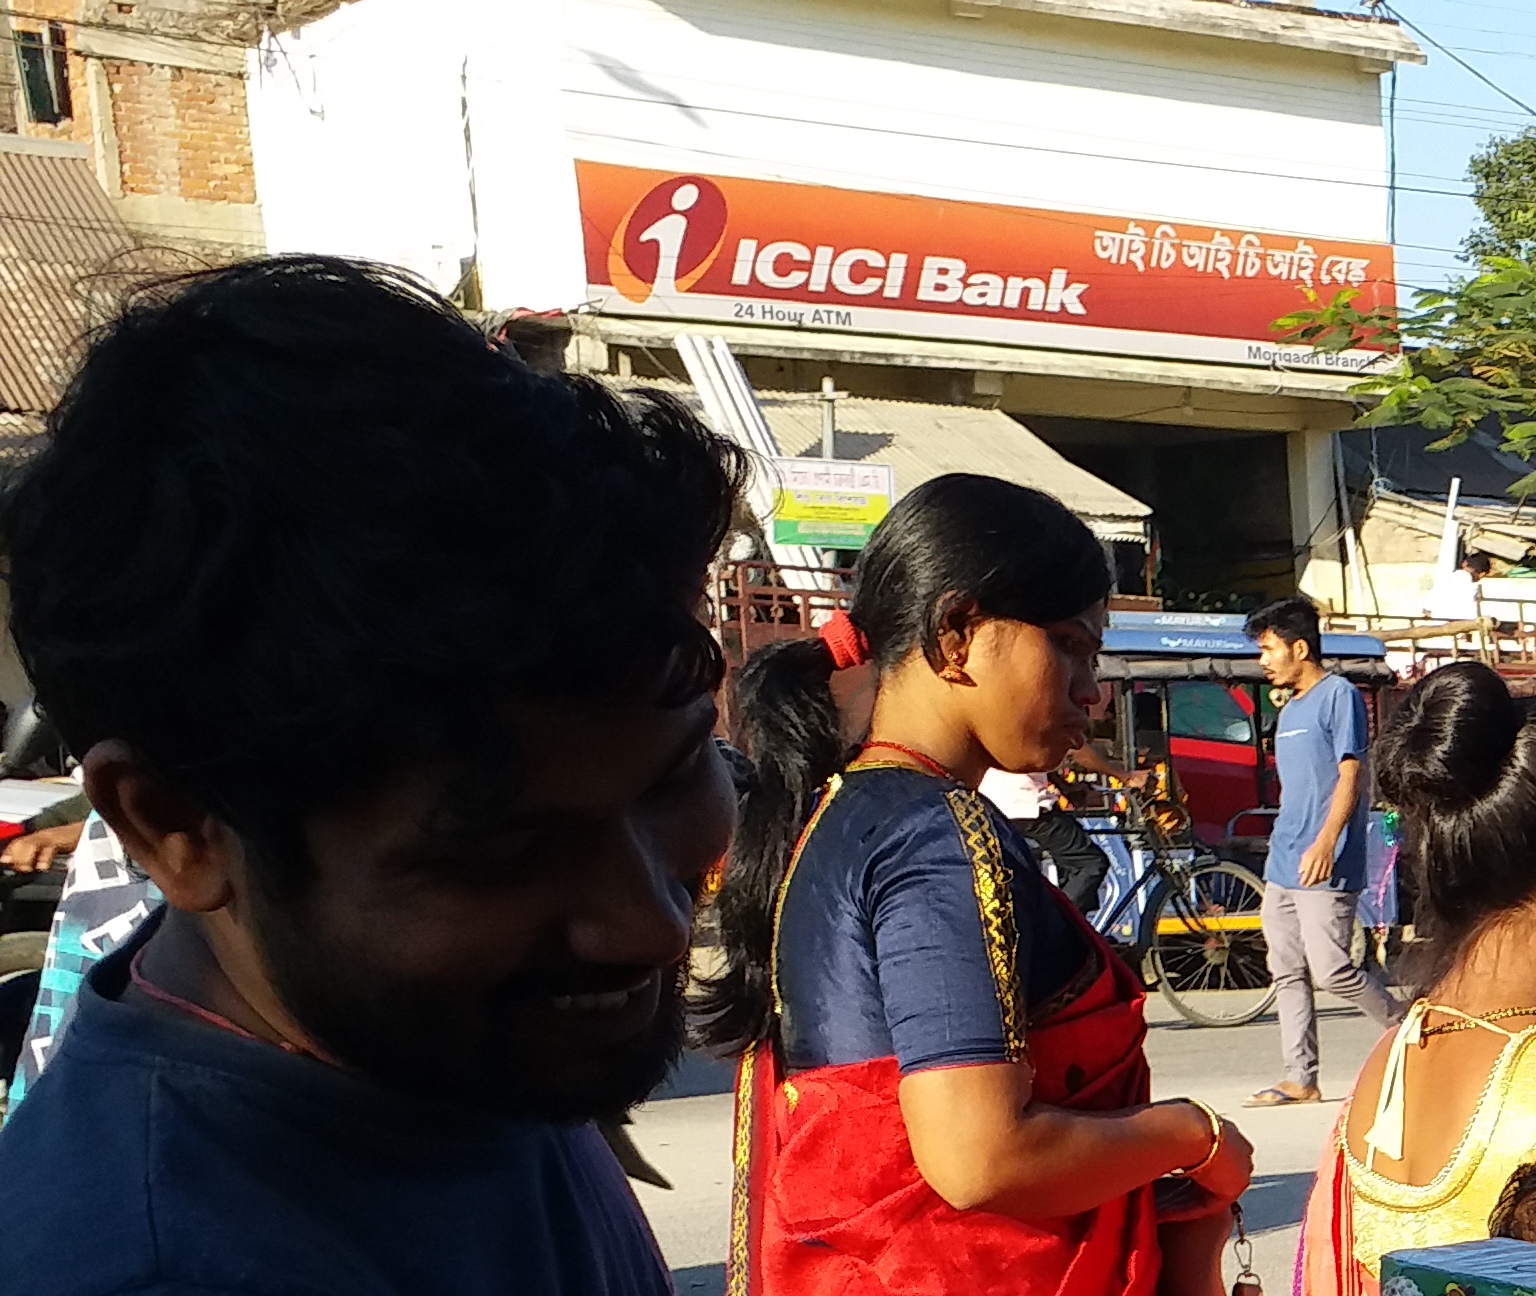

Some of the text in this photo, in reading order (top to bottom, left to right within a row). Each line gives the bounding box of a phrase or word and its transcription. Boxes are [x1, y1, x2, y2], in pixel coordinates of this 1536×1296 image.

[731, 239, 1088, 315] ICICI Bank
[734, 303, 852, 327] 24 Hour ATM
